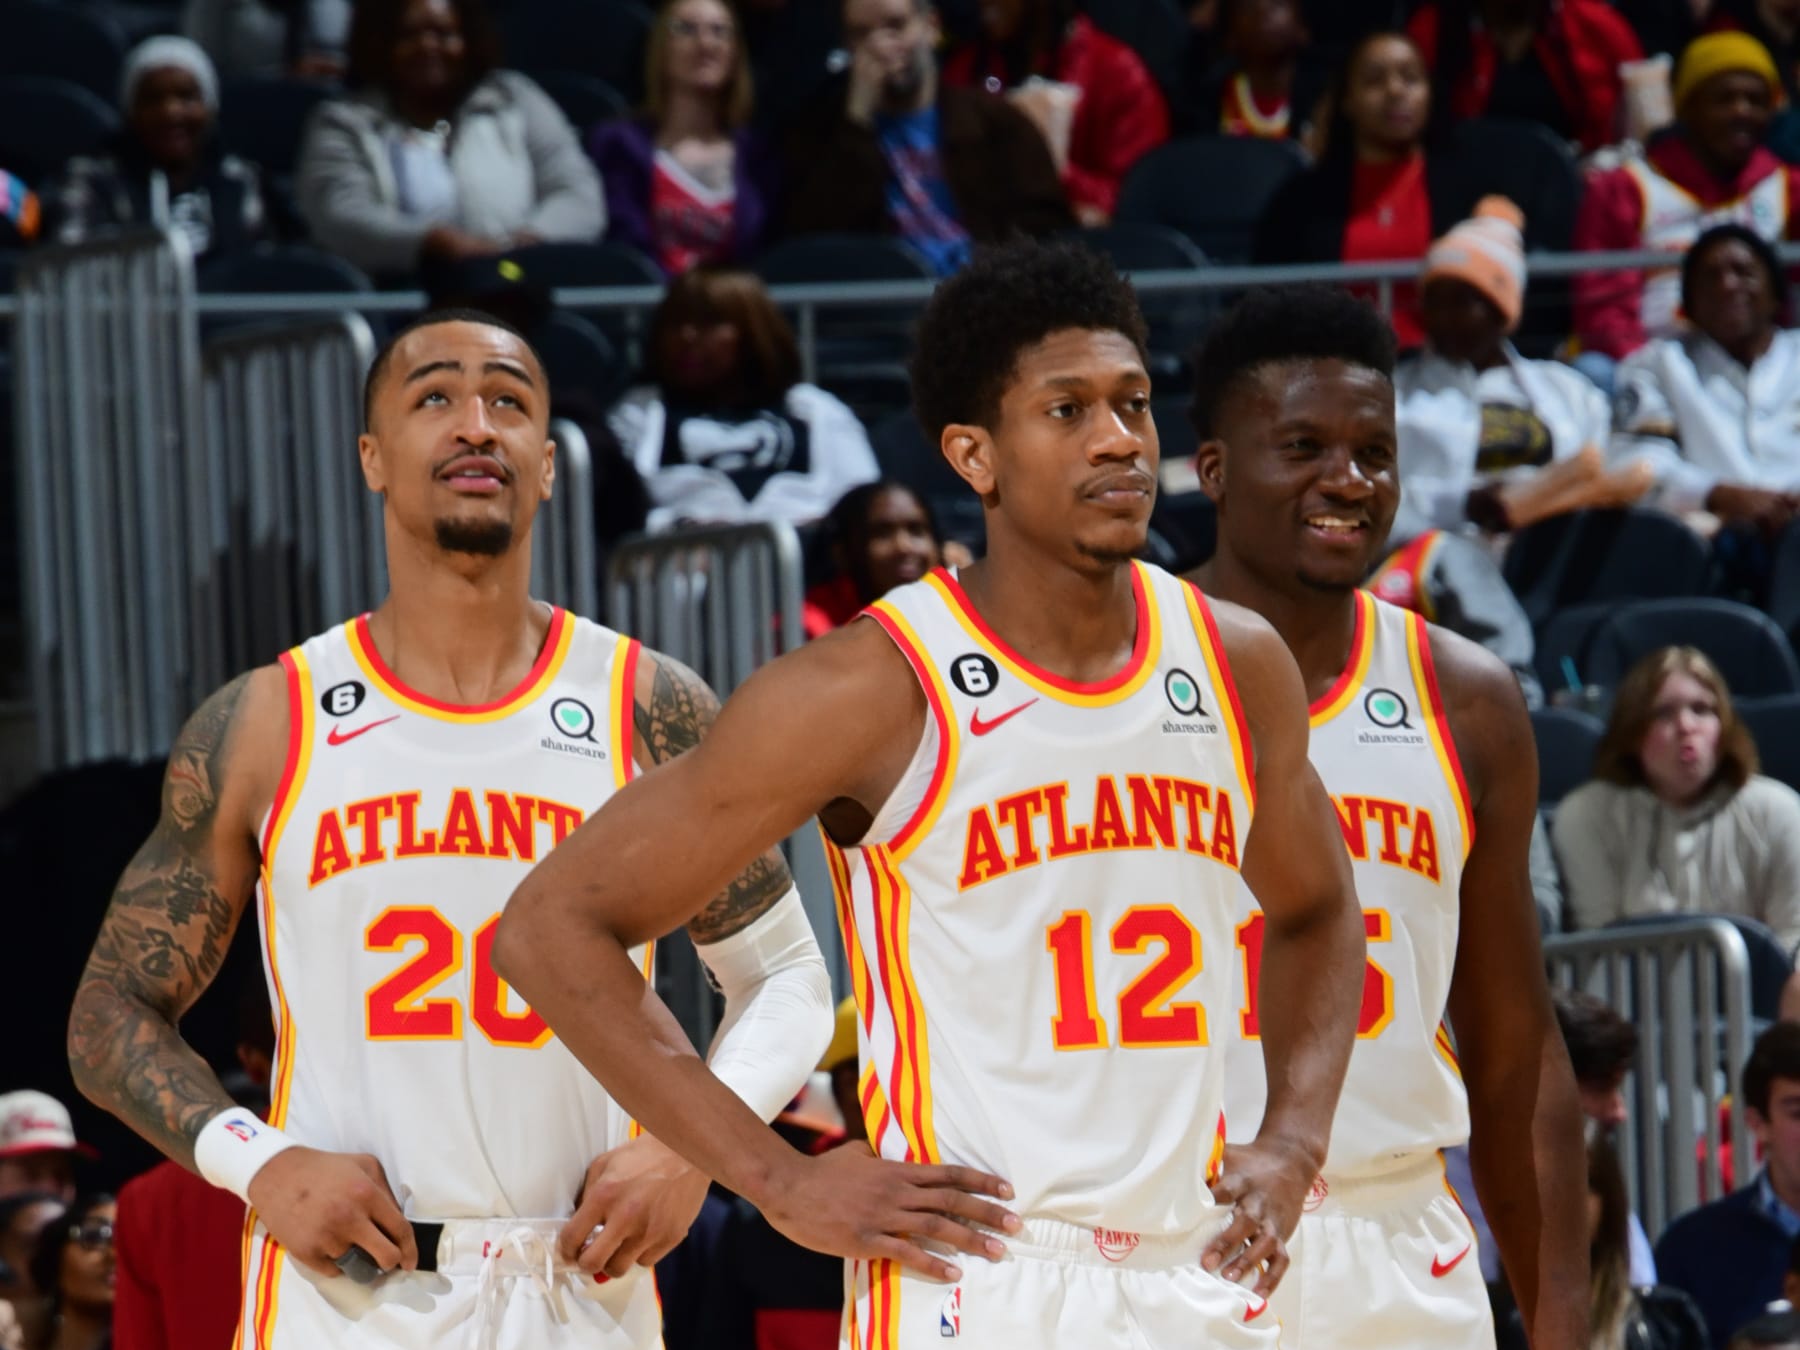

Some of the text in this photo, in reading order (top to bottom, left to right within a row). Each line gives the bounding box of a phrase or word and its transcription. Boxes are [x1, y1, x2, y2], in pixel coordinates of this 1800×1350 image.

[959, 655, 992, 693] 6
[331, 683, 357, 714] 6
[1161, 721, 1218, 734] sharecare
[1357, 732, 1424, 745] sharecare
[540, 737, 607, 759] sharecare
[307, 787, 585, 890] ATLANT
[957, 772, 1242, 890] ATLANTA
[1045, 903, 1210, 1052] 12
[1093, 1226, 1141, 1247] HAWKS
